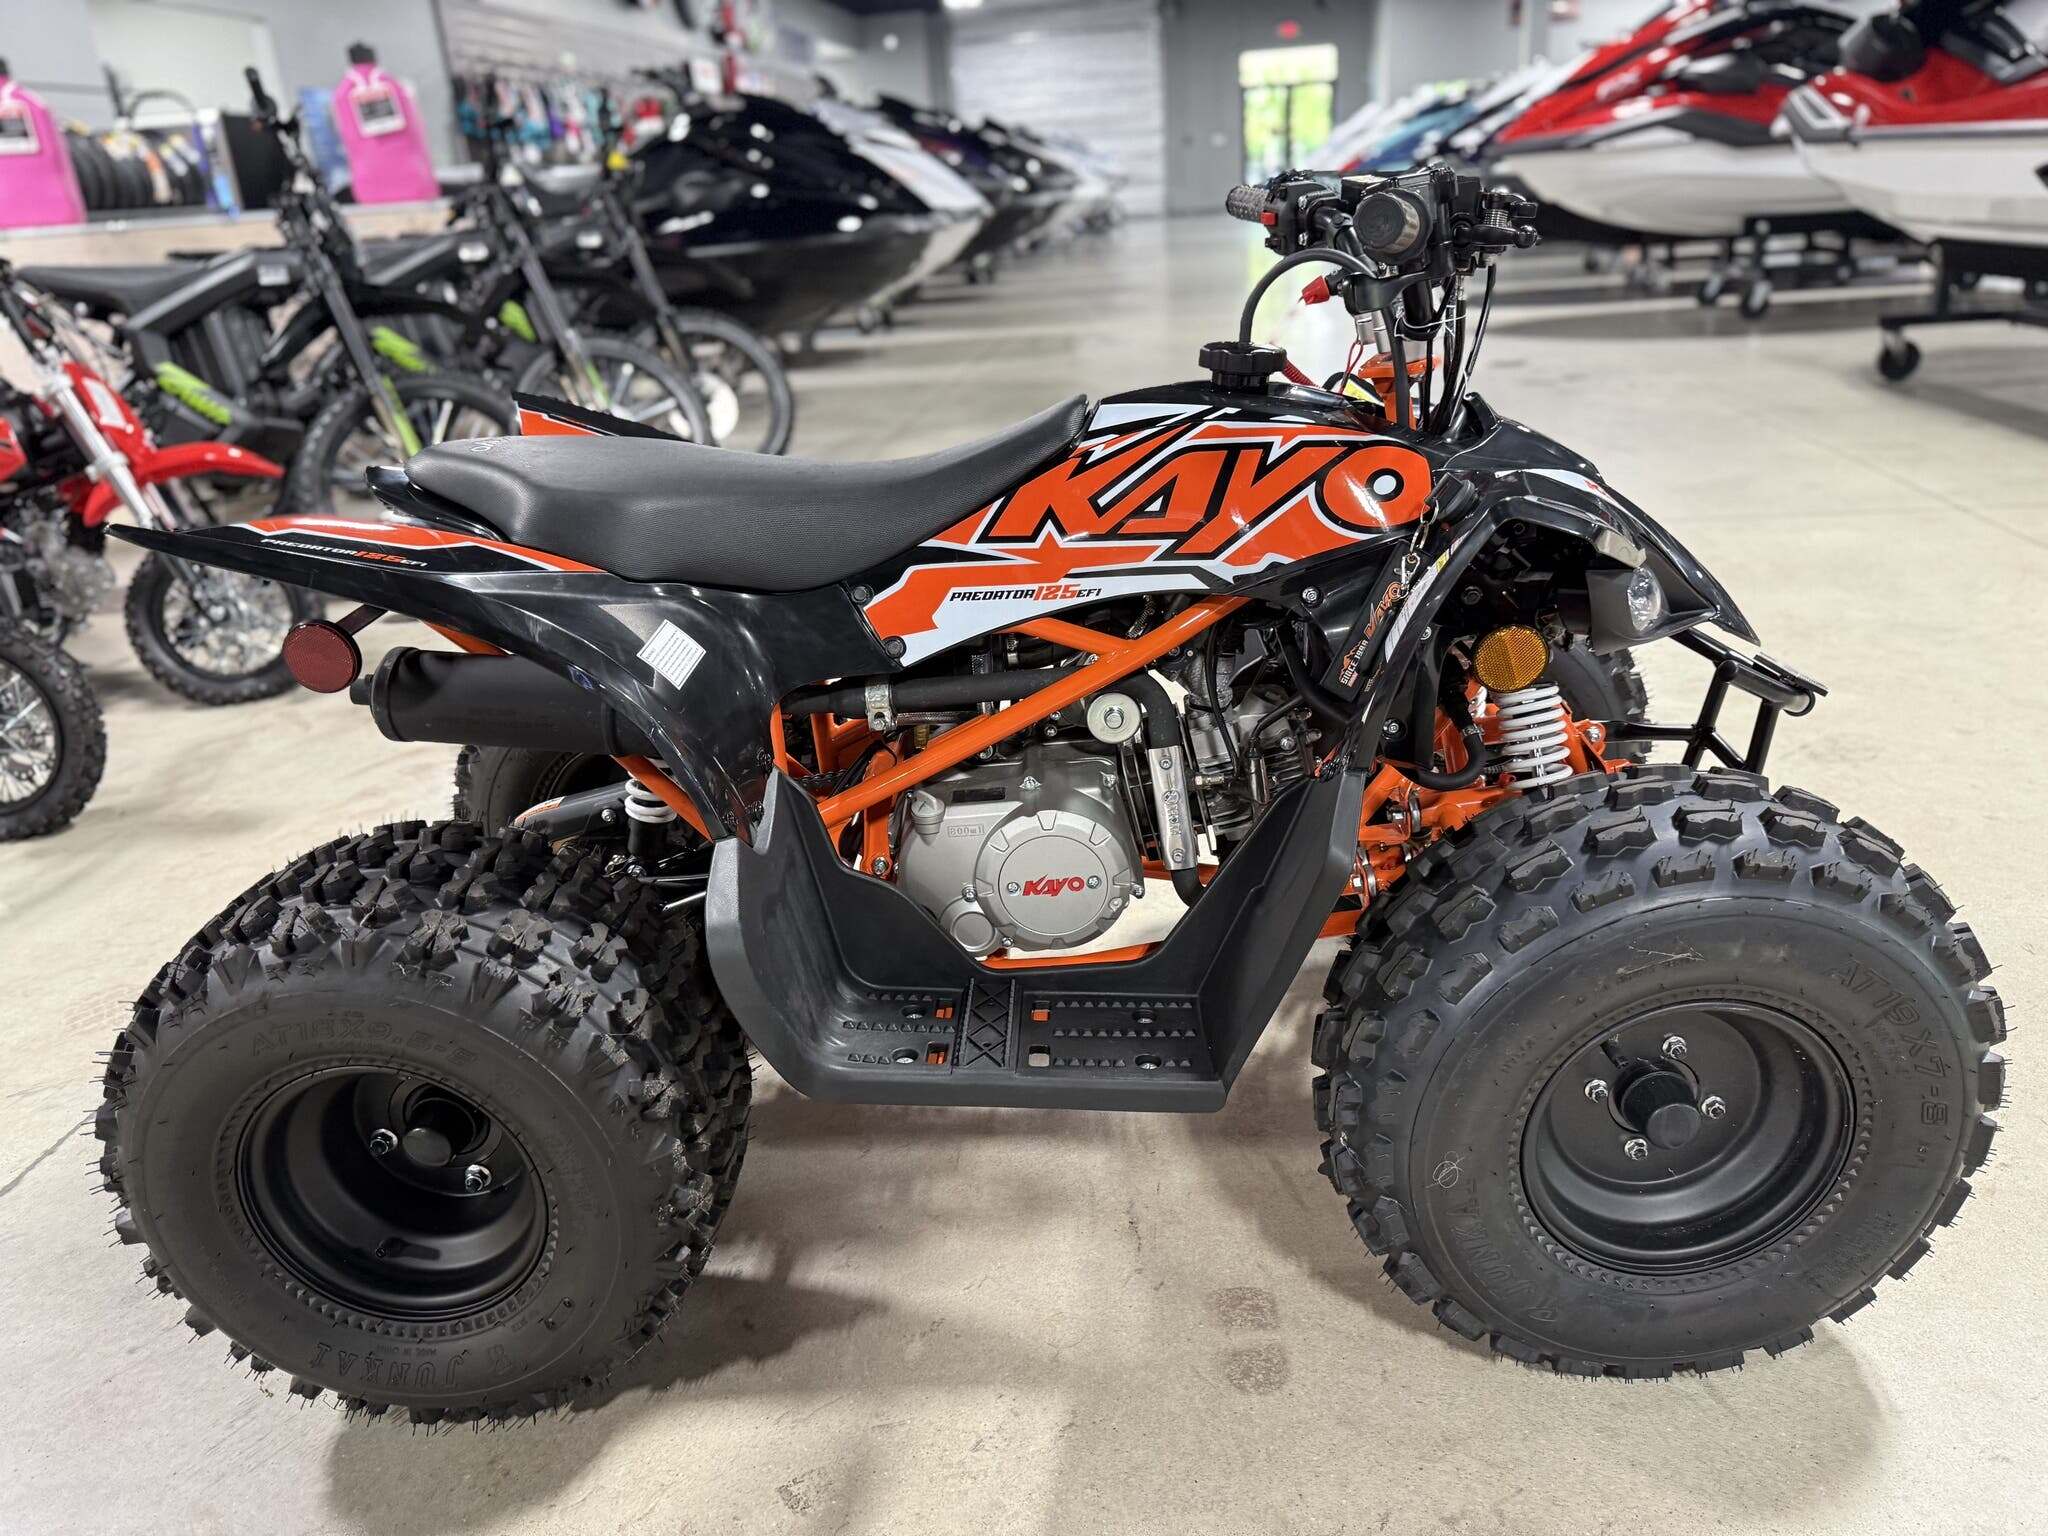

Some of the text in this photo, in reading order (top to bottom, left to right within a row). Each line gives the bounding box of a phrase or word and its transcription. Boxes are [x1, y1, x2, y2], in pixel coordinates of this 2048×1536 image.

[982, 426, 1432, 556] KAYO
[1341, 660, 1358, 685] SINCE
[1022, 873, 1085, 897] KAYO
